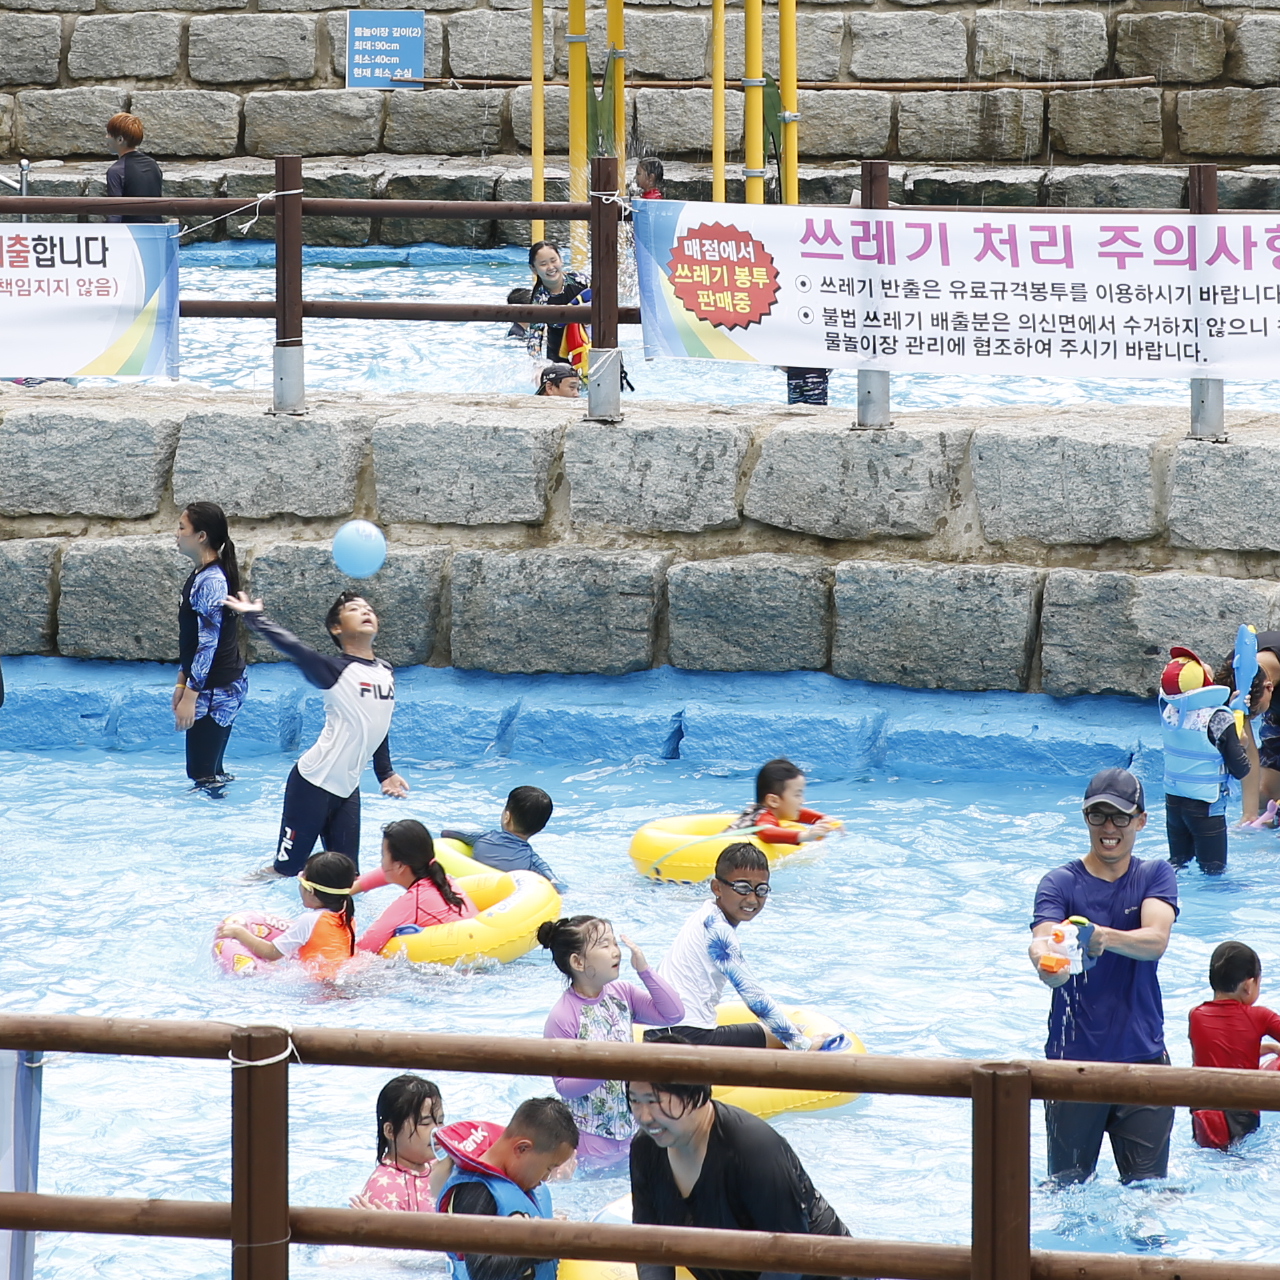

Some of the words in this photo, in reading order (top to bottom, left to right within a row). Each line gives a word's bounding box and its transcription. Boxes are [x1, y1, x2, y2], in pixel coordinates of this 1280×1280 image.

[353, 27, 389, 37] 물놀이장
[392, 27, 421, 38] 깊이(2)
[353, 54, 400, 64] 최소:40cm
[353, 68, 372, 78] 현재
[374, 68, 392, 78] 최소
[394, 68, 412, 78] 수심
[683, 237, 756, 263] 매점에서
[799, 218, 951, 267] 쓰레기
[973, 222, 1075, 269] 처리
[76, 276, 119, 298] 않음)
[674, 263, 729, 288] 쓰레기
[733, 265, 770, 289] 봉투
[696, 289, 751, 314] 판매중
[819, 275, 874, 299] 쓰레기
[880, 278, 942, 300] 반출은
[949, 279, 1088, 303] 유료규격봉투를
[1095, 282, 1193, 306] 이용하시기
[821, 306, 856, 329] 불법
[863, 309, 923, 331] 쓰레기
[930, 311, 1011, 333] 배출분은
[1018, 313, 1115, 336] 의신면에서
[1122, 315, 1200, 338] 수거하지
[1205, 316, 1268, 338] 않으니
[824, 333, 898, 356] 물놀이장
[904, 334, 966, 357] 관리에
[972, 335, 1053, 359] 협조하여
[1058, 339, 1118, 361] 주시기
[1125, 340, 1208, 363] 바랍니다.
[360, 682, 394, 700] FILA
[277, 826, 297, 862] FILA
